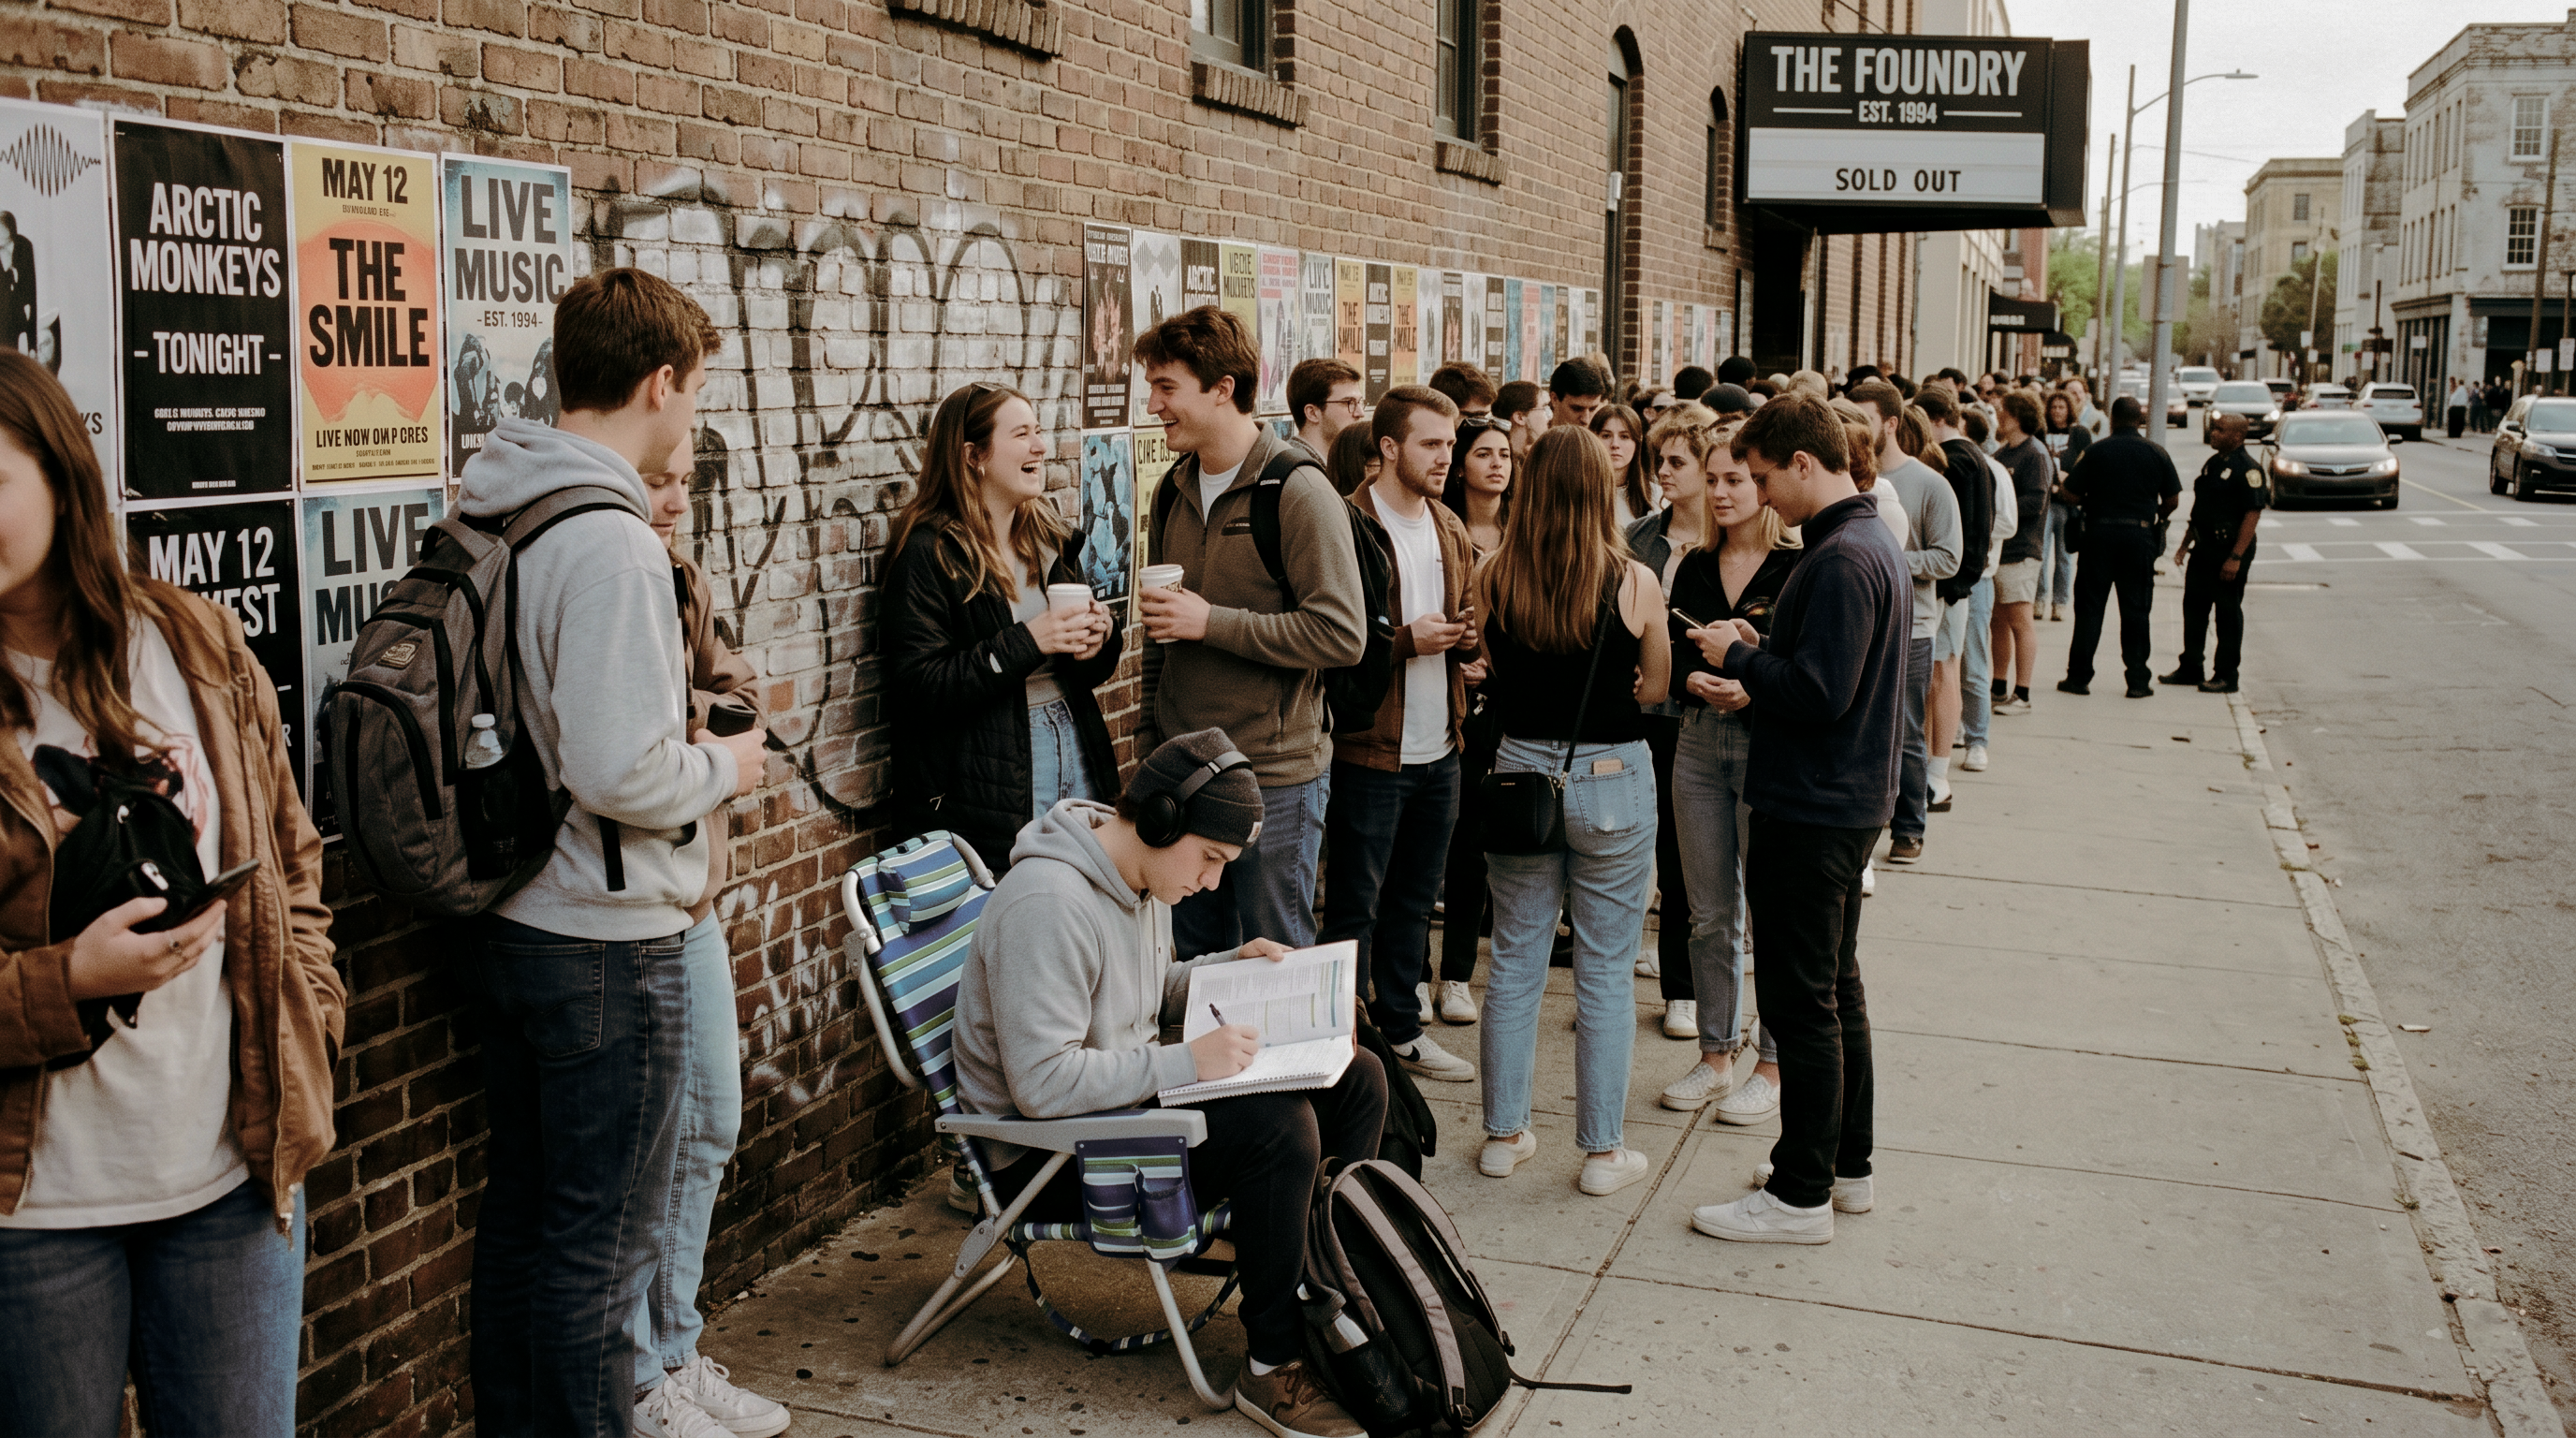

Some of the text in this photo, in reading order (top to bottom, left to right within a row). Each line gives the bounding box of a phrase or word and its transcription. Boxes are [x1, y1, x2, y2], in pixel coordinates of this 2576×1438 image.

[1771, 46, 2027, 95] THE FOUNDRY
[1858, 100, 1938, 124] EST. 1994
[322, 157, 408, 204] MAY 12
[461, 174, 556, 244] LIVE
[1836, 169, 1961, 192] SOLD OUT
[150, 182, 262, 242] ARCTIC
[130, 238, 281, 298] MONKEYS
[329, 237, 406, 301] THE
[455, 247, 565, 305] MUSIC
[153, 330, 264, 374] TONIGHT
[309, 304, 430, 367] SMILE
[316, 430, 342, 448] LIVE
[344, 428, 370, 447] NOW
[149, 526, 274, 586] MAY 12
[321, 503, 429, 577] LIVE
[315, 580, 400, 646] MU
